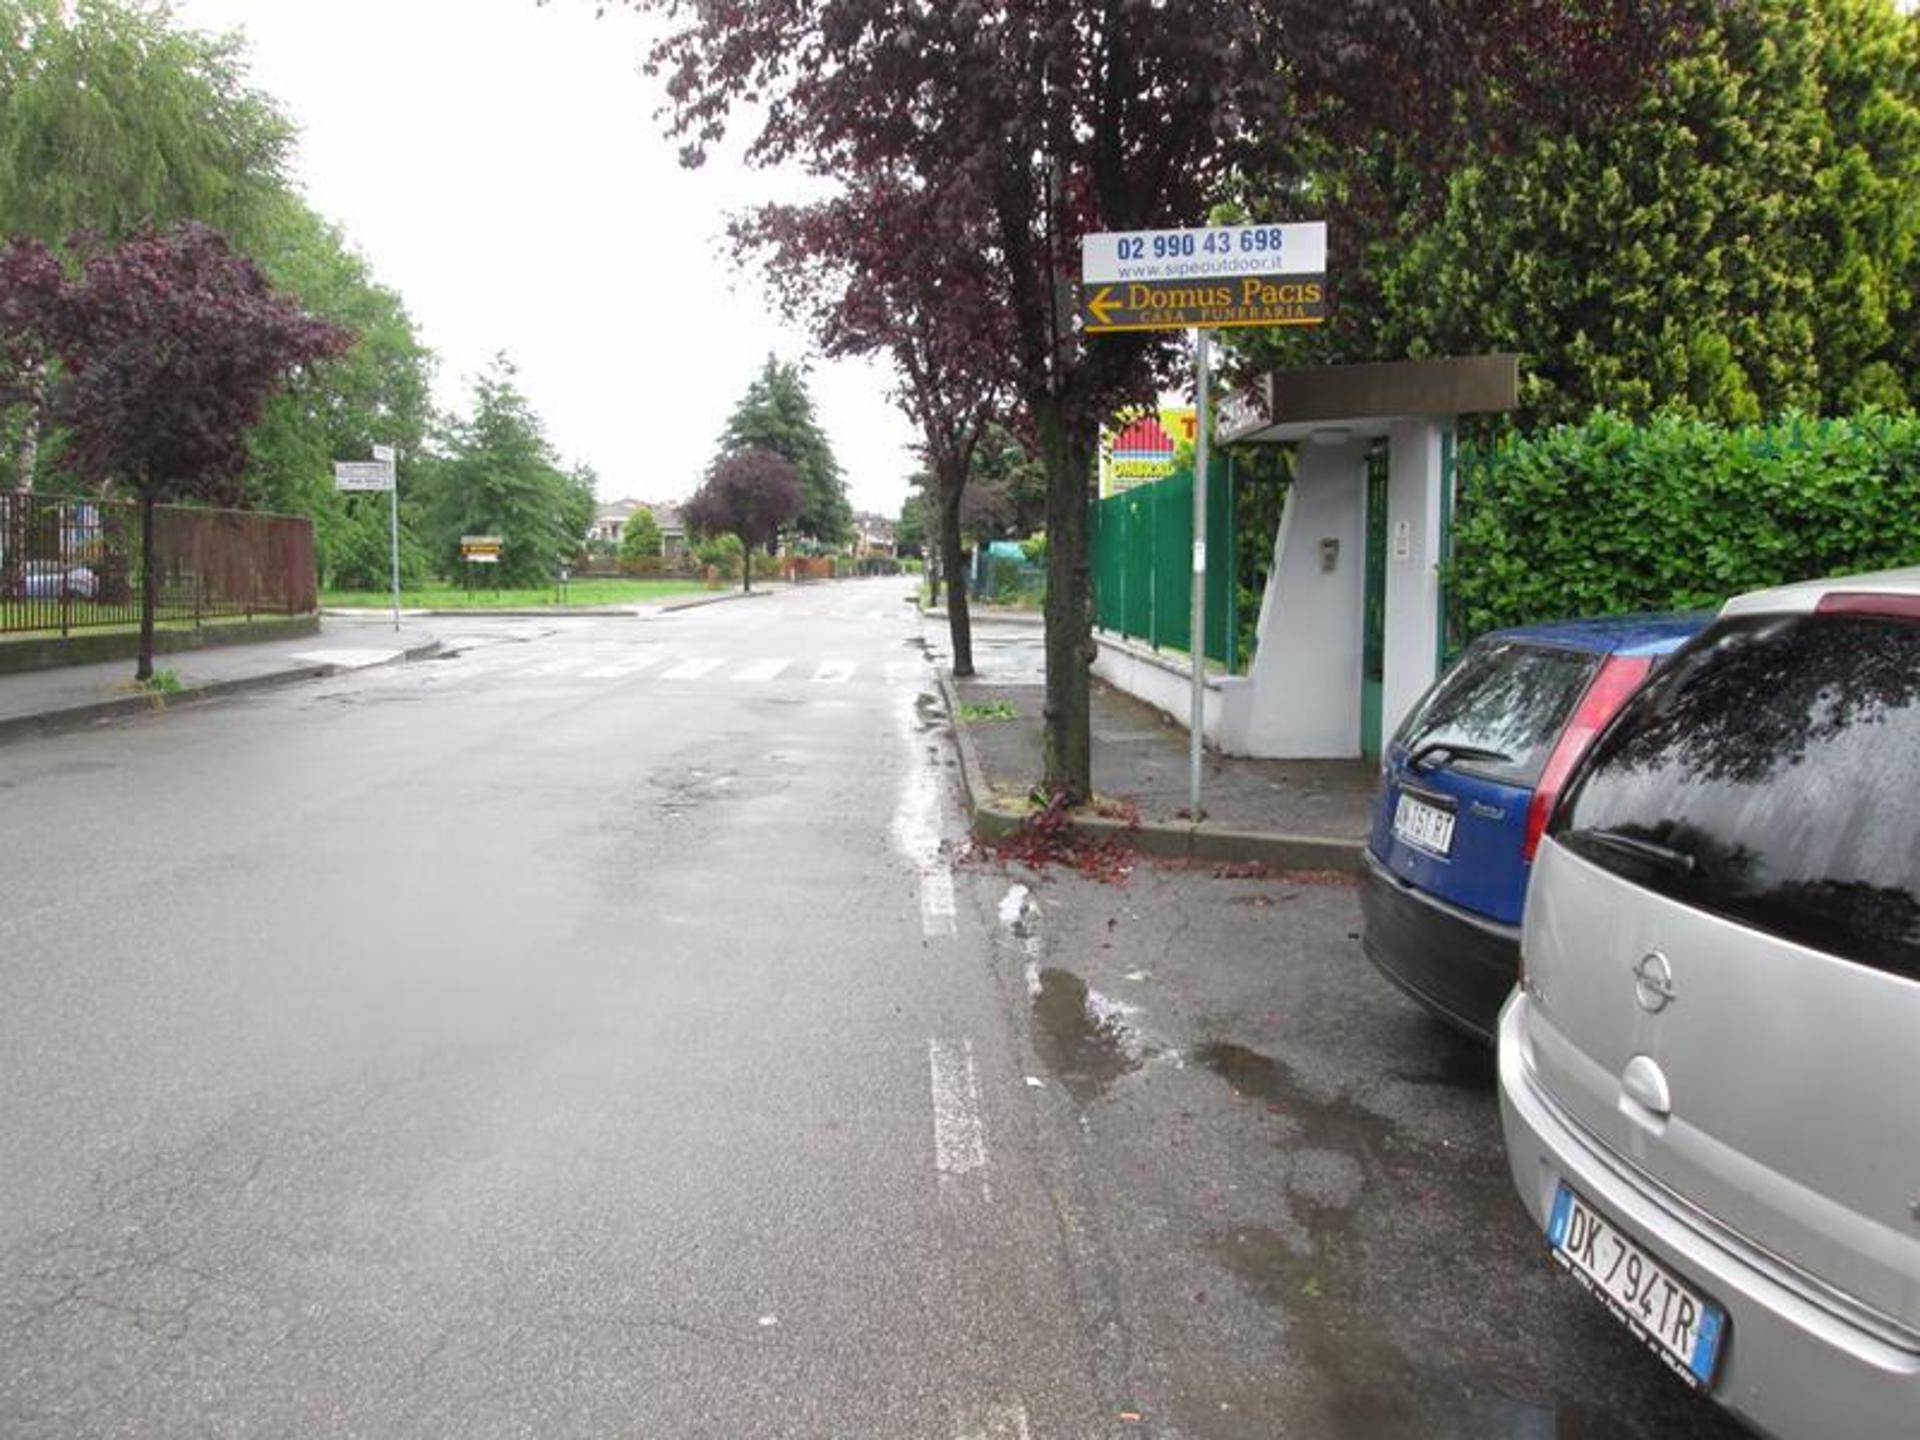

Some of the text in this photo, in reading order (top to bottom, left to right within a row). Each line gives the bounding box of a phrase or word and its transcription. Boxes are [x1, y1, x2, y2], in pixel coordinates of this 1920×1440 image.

[1117, 228, 1282, 260] 02 990 43 698
[1118, 256, 1282, 278] www.sipeoutdoor.it
[1129, 277, 1322, 310] Domus Pacis
[1139, 304, 1306, 322] CASA FUNERARIA
[1568, 1206, 1602, 1270] DK
